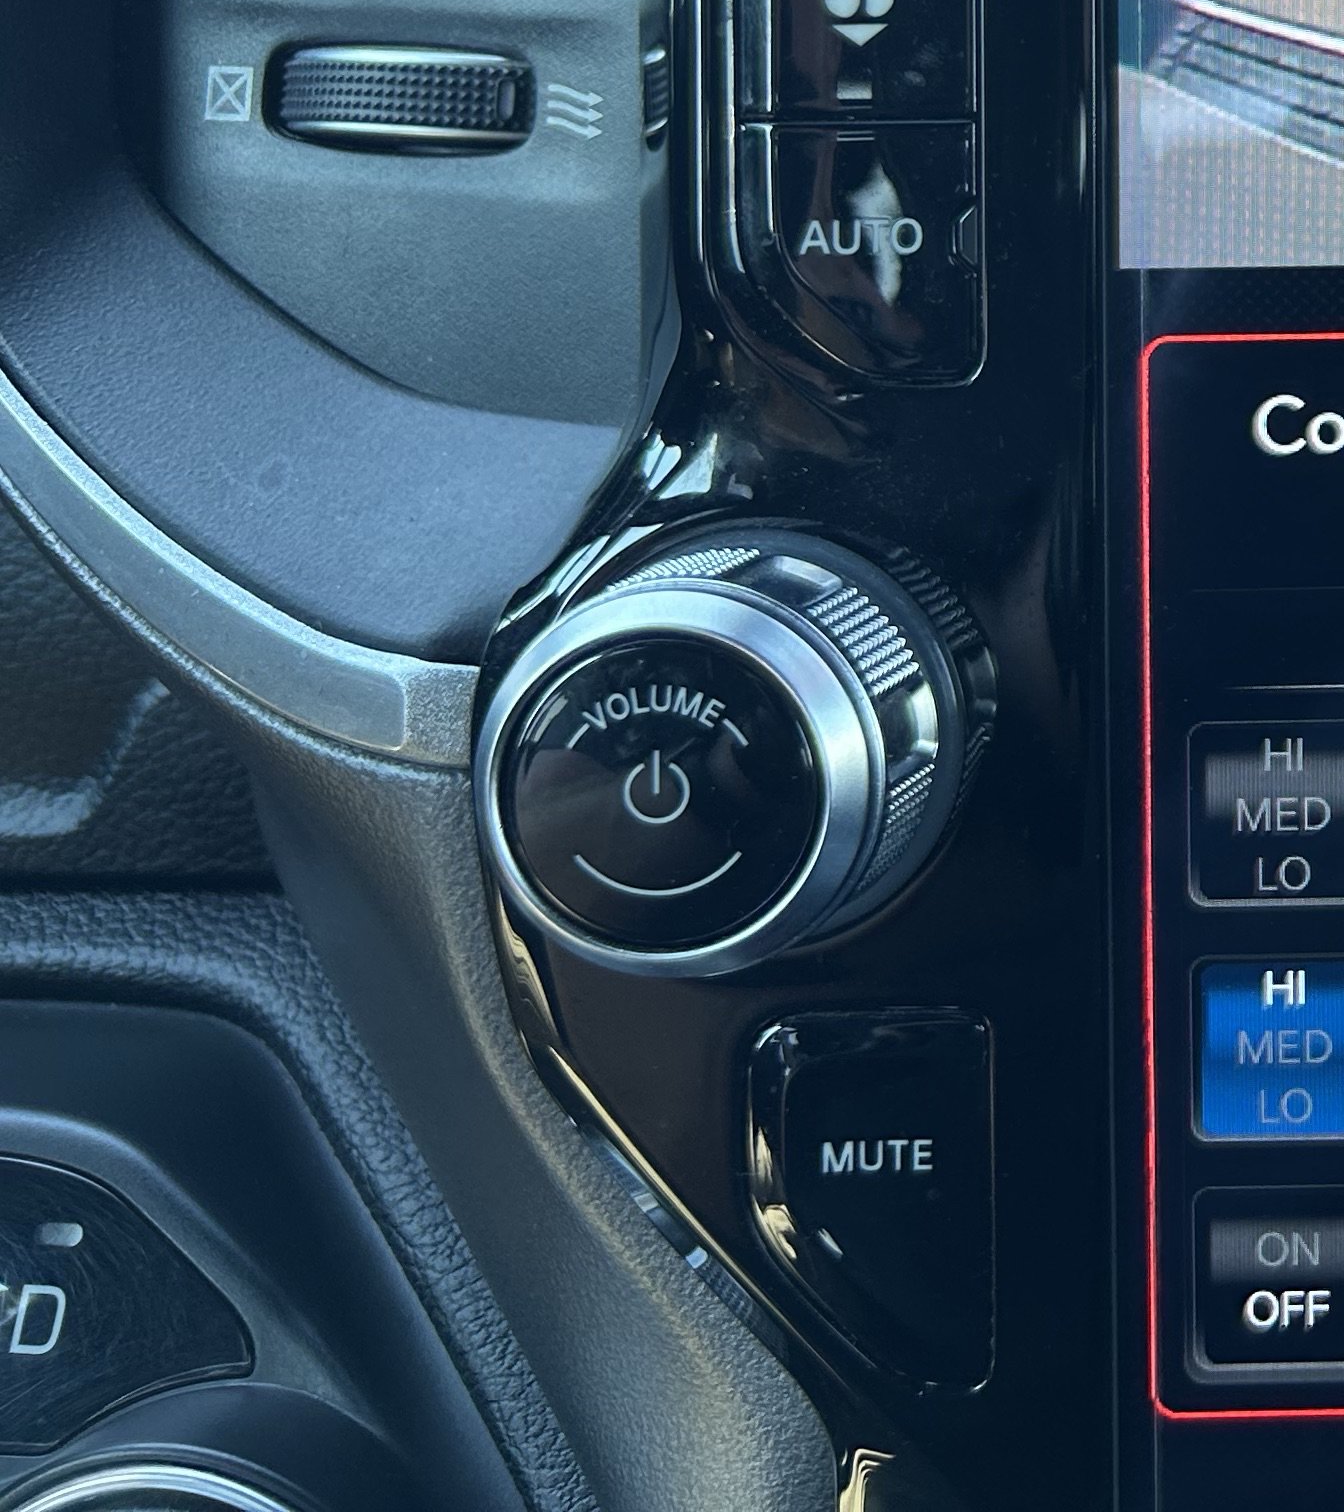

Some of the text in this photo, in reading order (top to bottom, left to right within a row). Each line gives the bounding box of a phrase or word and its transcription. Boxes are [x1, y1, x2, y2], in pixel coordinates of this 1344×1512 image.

[800, 218, 922, 256] AUTO
[584, 684, 728, 731] VOLUME
[1261, 738, 1305, 774] HI
[1234, 797, 1331, 833] MED
[1256, 858, 1311, 891] LO
[1261, 971, 1306, 1007] HI
[1236, 1030, 1332, 1065] MED
[1258, 1089, 1312, 1124] LO
[822, 1139, 933, 1174] MUTE
[1255, 1232, 1320, 1267] ON
[1244, 1291, 1331, 1330] OFF
